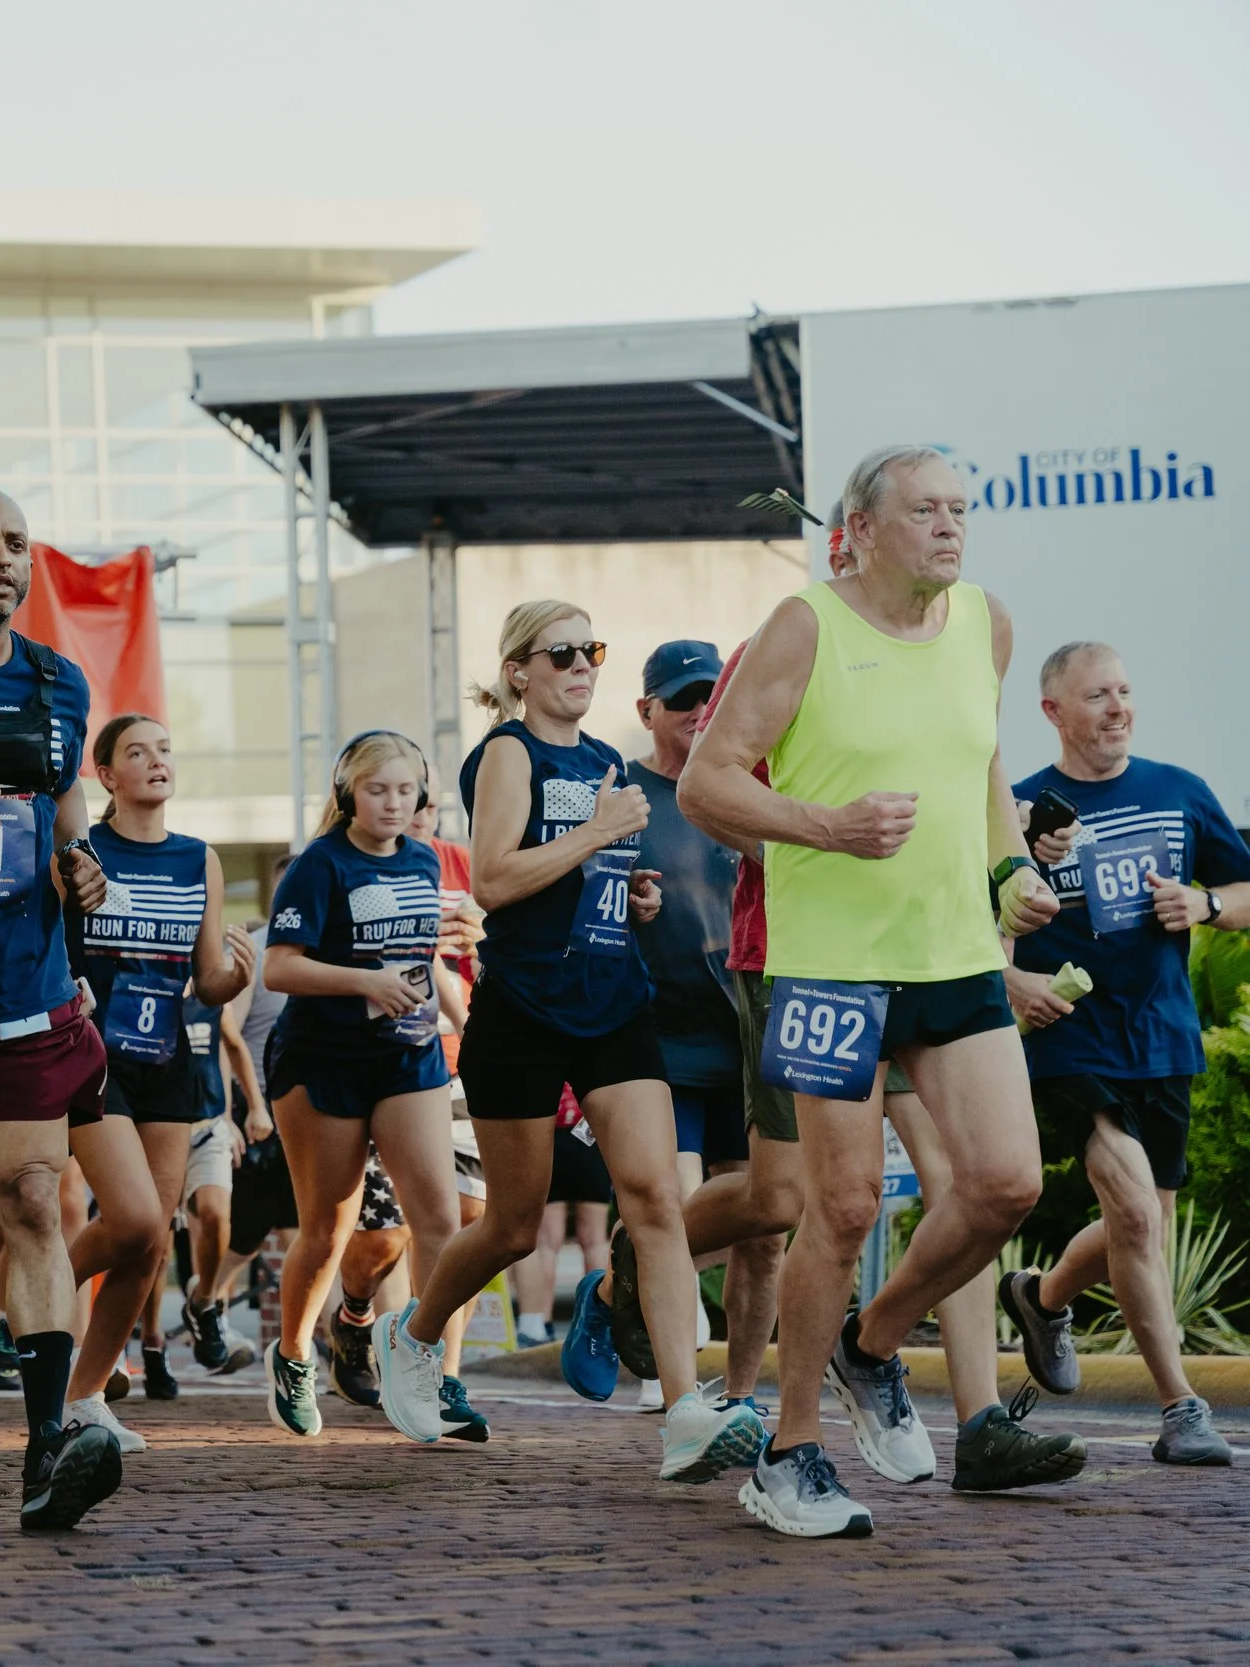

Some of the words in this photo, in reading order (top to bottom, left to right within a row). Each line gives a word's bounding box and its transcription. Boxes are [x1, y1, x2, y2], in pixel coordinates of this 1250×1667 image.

[1035, 450, 1086, 468] CITY
[1092, 447, 1121, 464] OF
[1059, 868, 1082, 889] RU
[1095, 855, 1158, 901] 693
[597, 879, 628, 923] 40
[92, 917, 123, 936] RUN
[128, 920, 155, 940] FOR
[160, 922, 198, 943] HEROE
[363, 921, 392, 940] RUN
[393, 918, 416, 936] FOR
[138, 997, 156, 1033] 8
[780, 1000, 865, 1061] 692
[792, 1071, 821, 1081] Lexington
[822, 1076, 844, 1086] Health
[390, 1314, 400, 1350] HOKA
